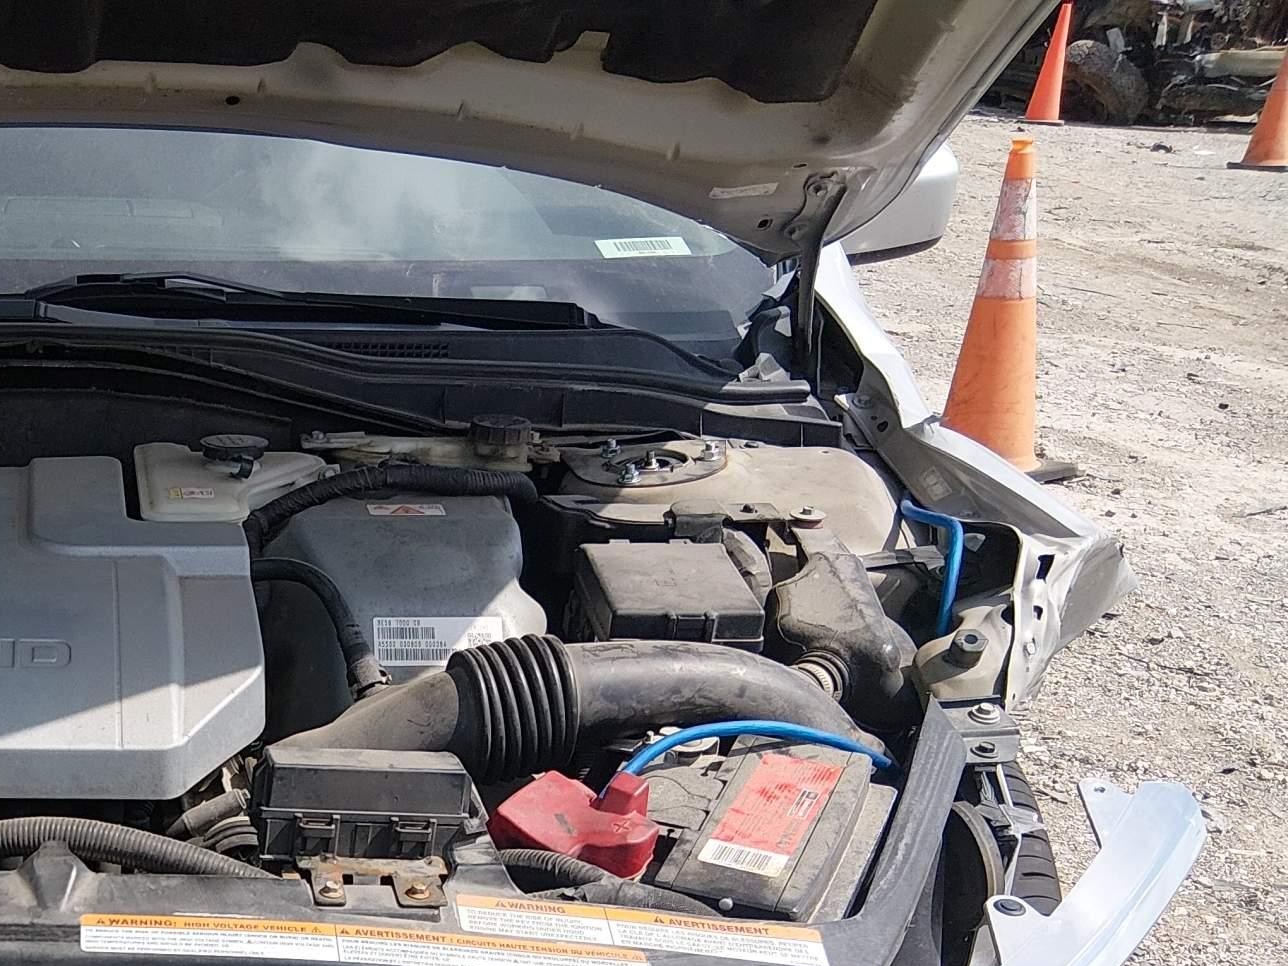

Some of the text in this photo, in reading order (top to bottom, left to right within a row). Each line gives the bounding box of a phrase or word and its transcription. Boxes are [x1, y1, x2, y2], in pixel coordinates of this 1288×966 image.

[507, 900, 566, 914] WARNING
[108, 918, 177, 928] WARNING:
[213, 922, 259, 930] VOLTAGE
[263, 924, 307, 933] VEHICLE
[669, 918, 769, 936] AVERTISSEMENT
[355, 929, 446, 943] AVERTISSEMENT
[456, 938, 497, 948] CIRCUITS
[499, 943, 528, 951] HAUTE
[530, 945, 568, 954] TENSION
